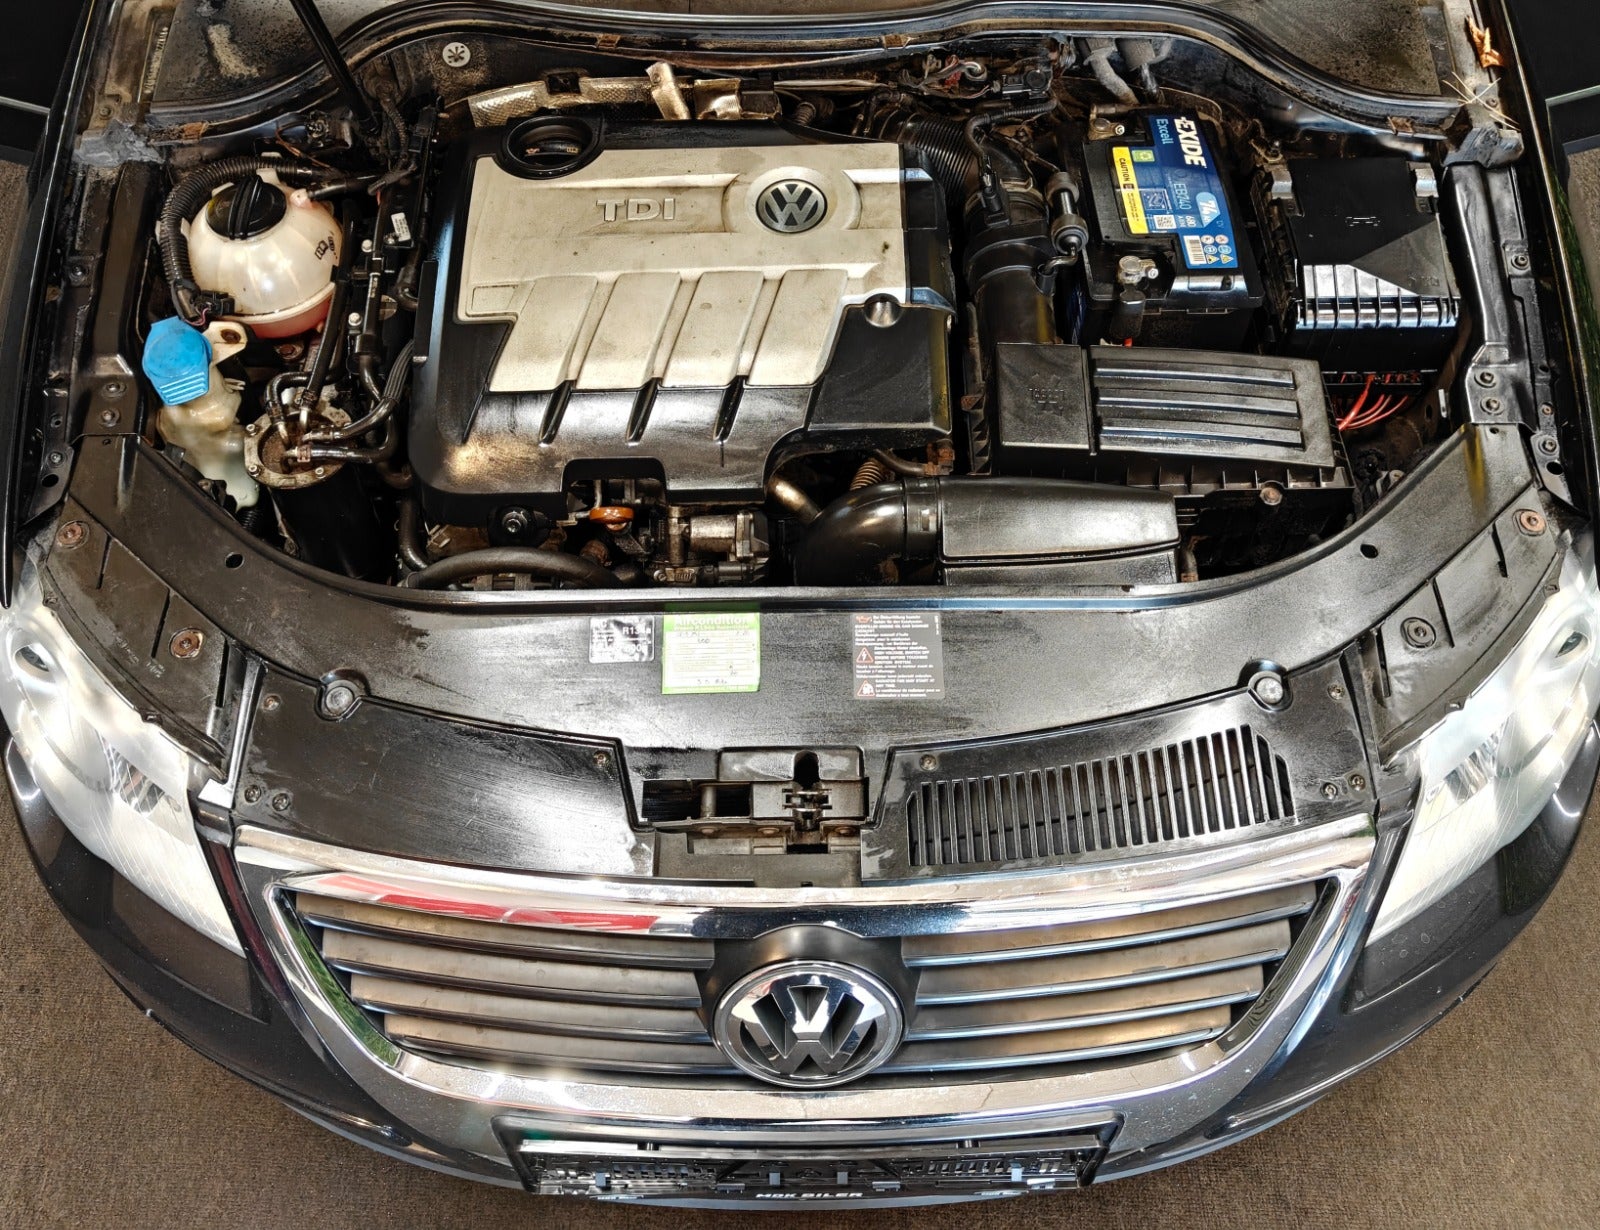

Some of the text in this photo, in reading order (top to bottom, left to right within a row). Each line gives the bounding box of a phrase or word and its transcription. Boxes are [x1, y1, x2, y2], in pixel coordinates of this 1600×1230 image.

[1156, 118, 1174, 144] Excell
[1174, 117, 1206, 167] EXIDE
[1119, 158, 1130, 181] CAUTION
[760, 182, 823, 230] VW
[1173, 183, 1192, 210] EB740
[1199, 200, 1218, 215] 74
[596, 198, 676, 222] TDI
[722, 967, 896, 1081] VW
